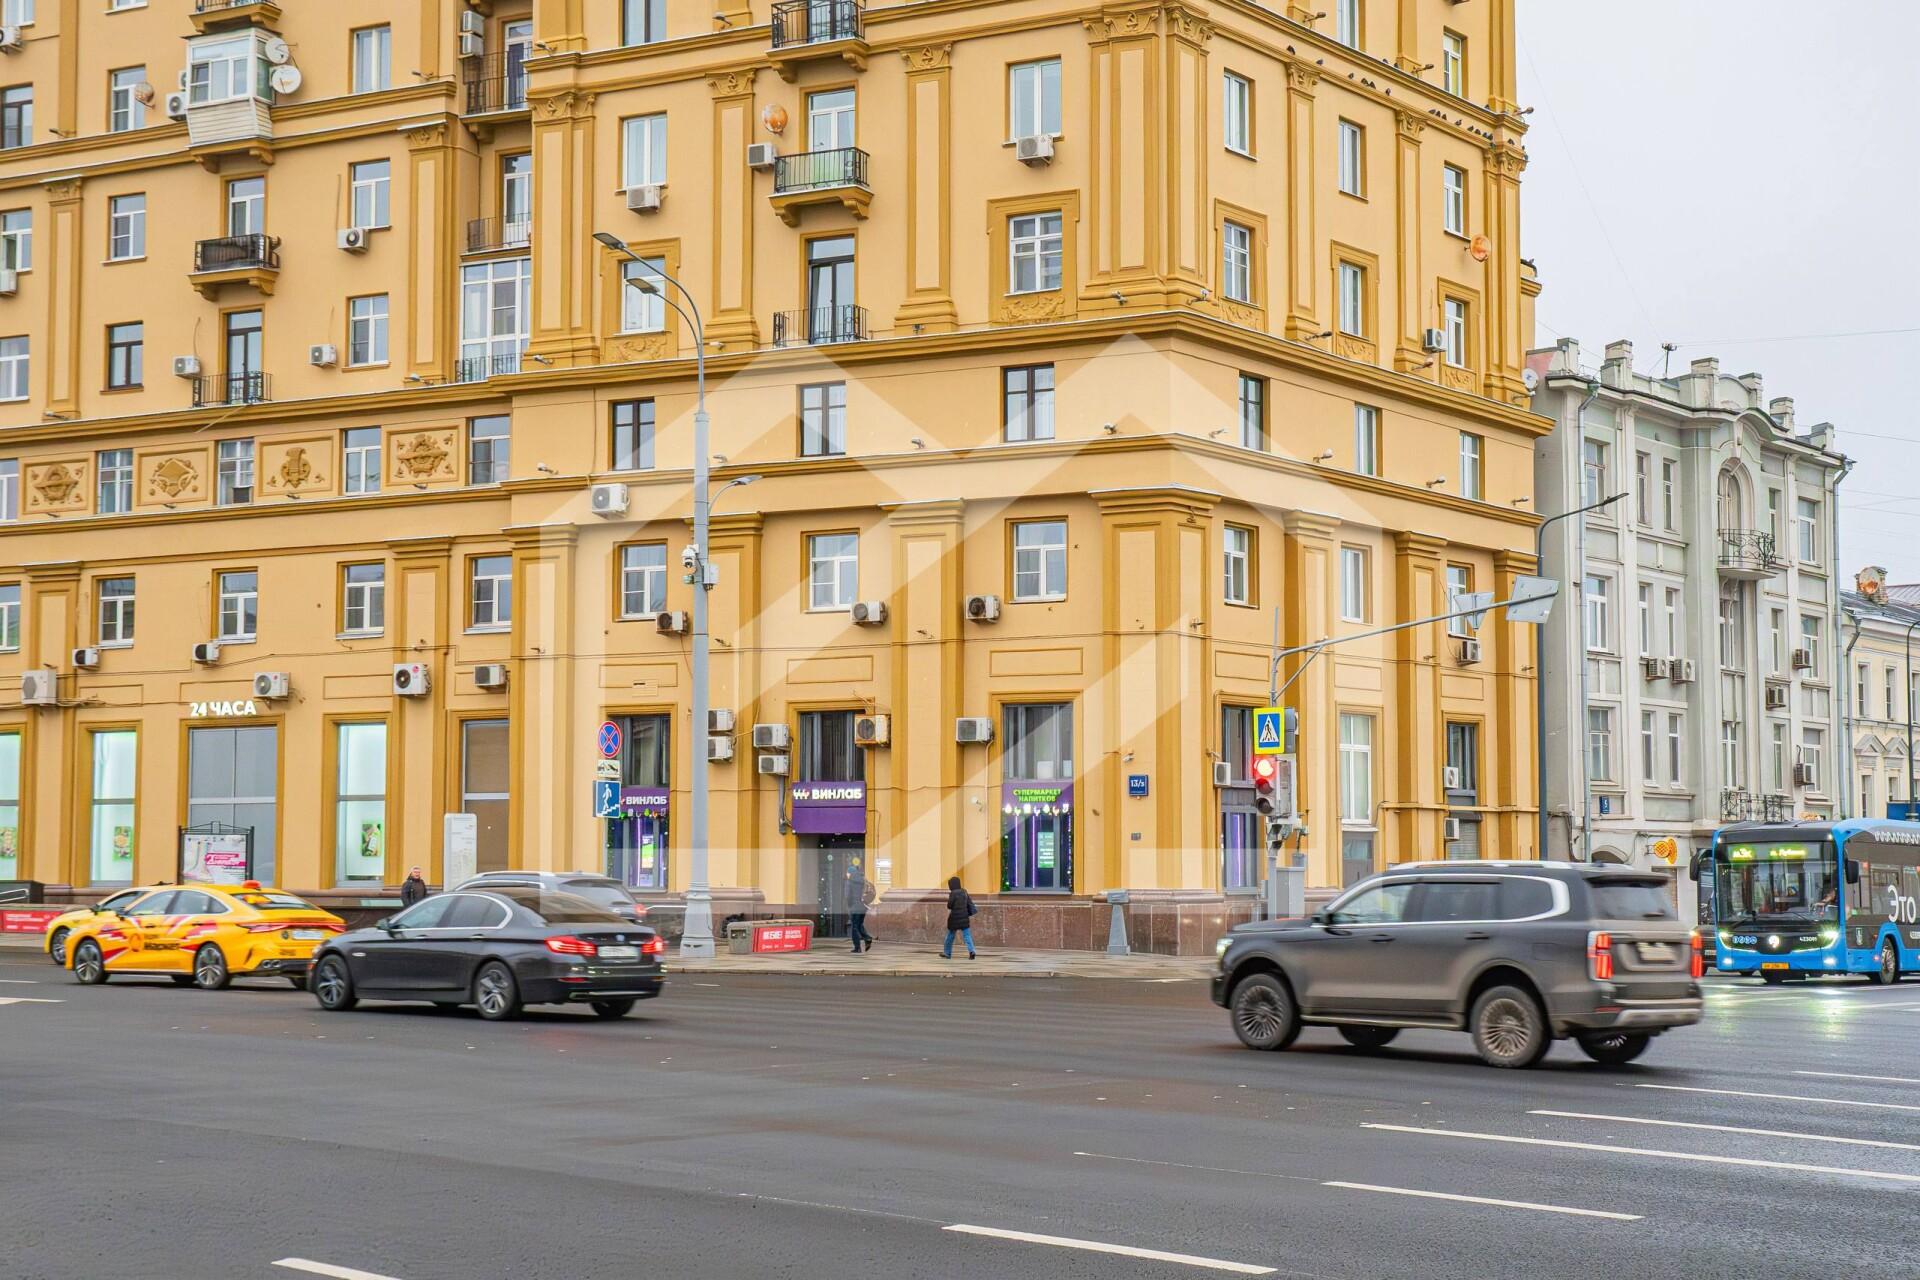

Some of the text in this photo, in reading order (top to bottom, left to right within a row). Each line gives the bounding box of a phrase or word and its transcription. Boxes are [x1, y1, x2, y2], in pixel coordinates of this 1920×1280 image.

[190, 701, 257, 717] 24 ЧАСА
[811, 788, 862, 800] ВИНЛАБ
[1013, 788, 1062, 796] СУПЕРМАРКЕТ
[626, 796, 667, 805] ВИНЛАБ
[1019, 795, 1056, 803] НАПИТКОВ
[1887, 884, 1917, 924] Это
